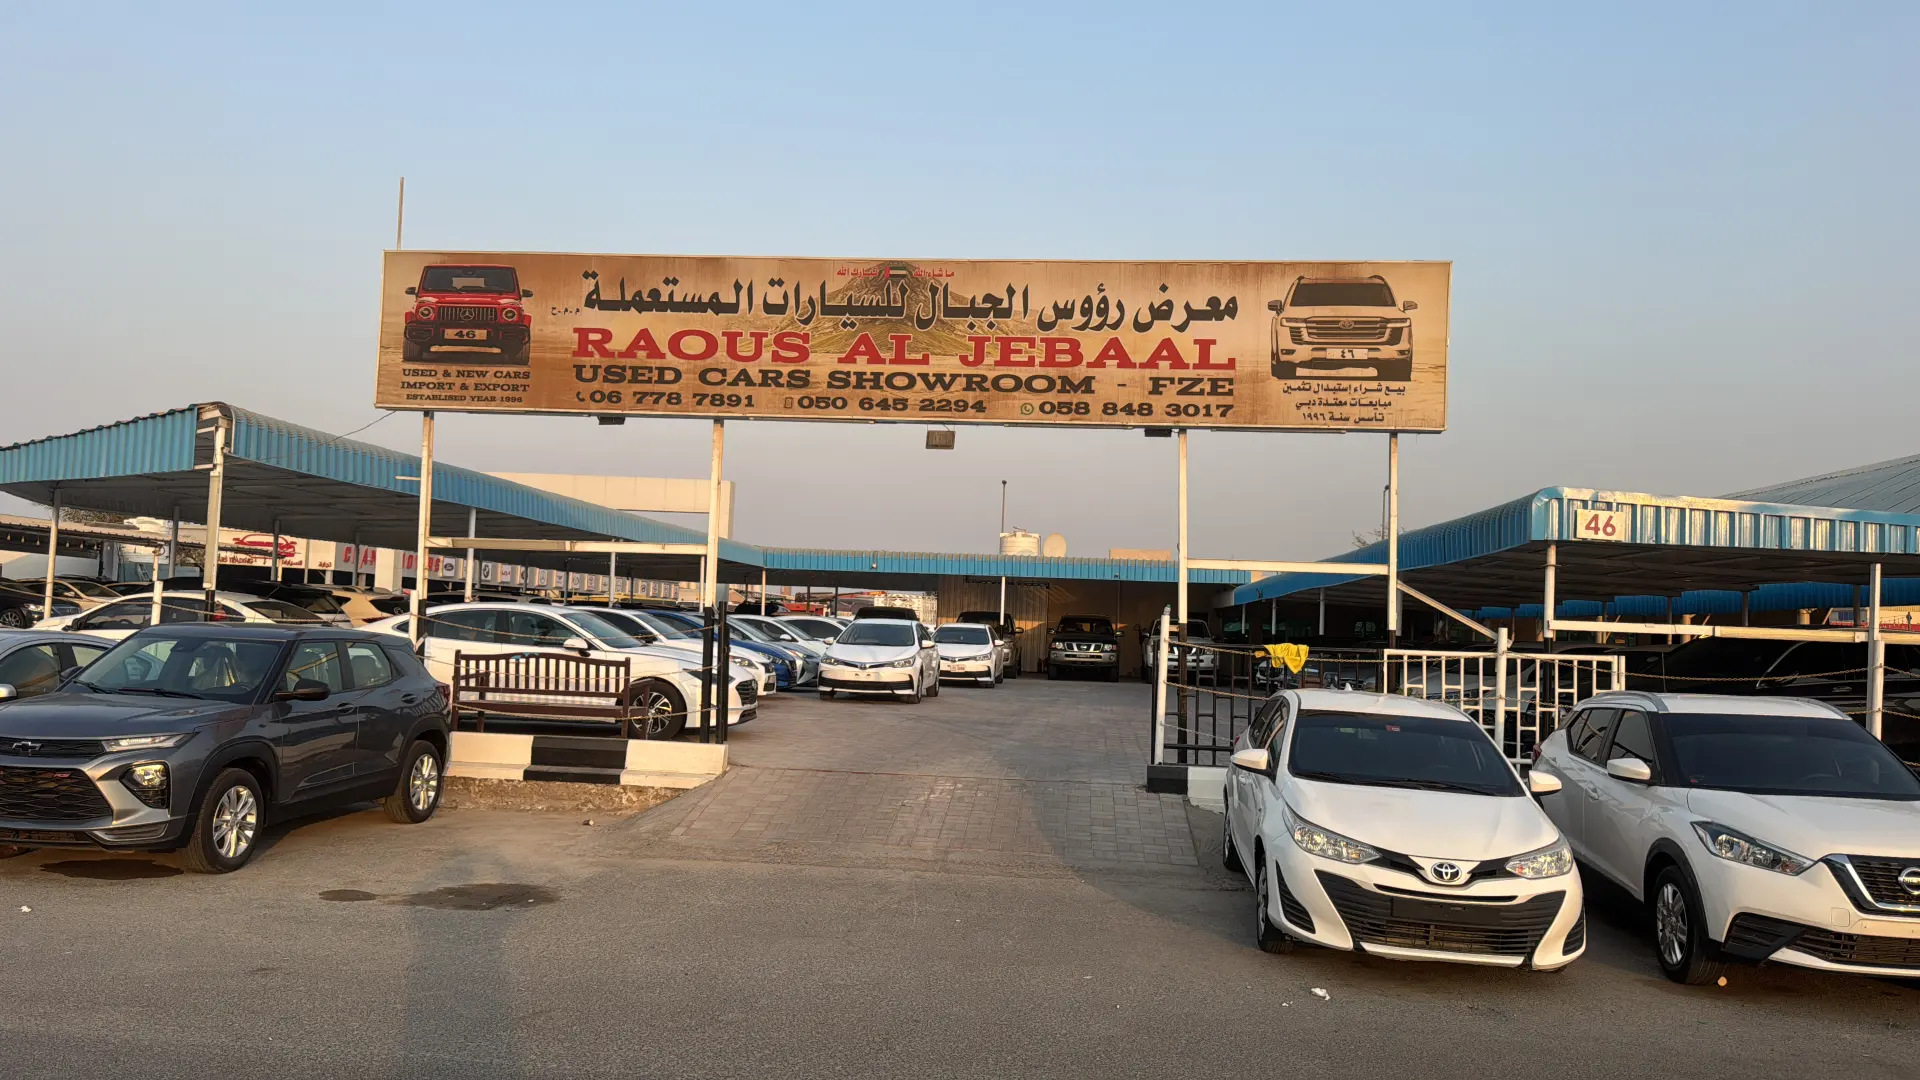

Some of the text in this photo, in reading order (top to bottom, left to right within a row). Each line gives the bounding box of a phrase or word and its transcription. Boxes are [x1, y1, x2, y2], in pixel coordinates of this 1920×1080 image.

[836, 267, 849, 277] الله
[945, 268, 955, 278] ما
[581, 269, 754, 317] المستعملة
[762, 276, 909, 331] للسيارات
[914, 280, 1029, 332] الجبال
[1037, 282, 1126, 333] رؤوس
[1132, 282, 1239, 334] معرض
[454, 330, 477, 340] 46
[572, 327, 1237, 371] RAOUS AL JEBAAL
[1340, 349, 1355, 359] ٤٦
[402, 368, 531, 380] USED & NEW CARS
[572, 364, 683, 385] USED
[697, 367, 812, 389] CARS
[826, 370, 1096, 395] SHOWROOM
[1148, 376, 1235, 397] FZE
[400, 381, 530, 393] IMPORT & EXPORT
[1353, 382, 1383, 395] شراء
[1384, 385, 1407, 396] بيع
[405, 393, 467, 402] ESTABLISED
[470, 395, 497, 403] YEAR
[589, 390, 756, 408] 06 778 7891
[797, 395, 987, 413] 050 645 2294
[1295, 398, 1317, 410] دبي
[1349, 397, 1392, 411] مبايعات
[1038, 401, 1235, 418] 058 848 3017
[1302, 411, 1326, 421] ١٩٩٦
[1328, 411, 1350, 422] سنة
[1584, 513, 1617, 537] 46
